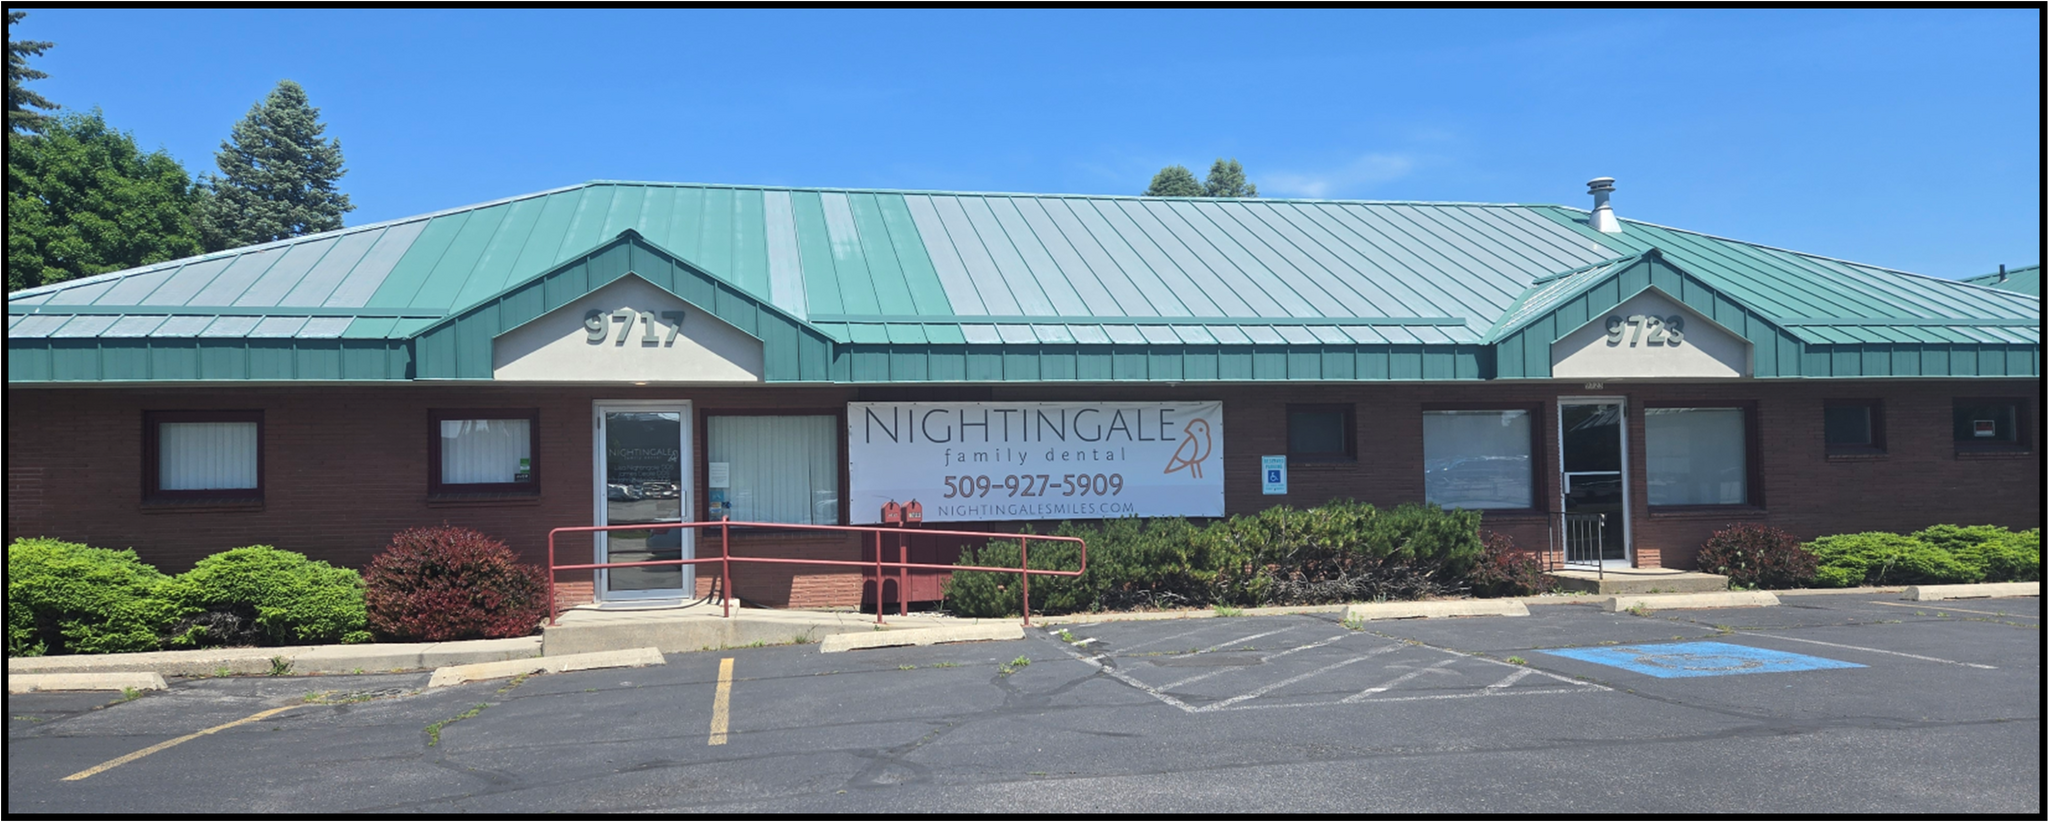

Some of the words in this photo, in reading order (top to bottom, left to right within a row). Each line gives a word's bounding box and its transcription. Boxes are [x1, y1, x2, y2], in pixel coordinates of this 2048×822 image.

[584, 309, 685, 344] 9717
[1605, 315, 1684, 344] 9723
[865, 406, 1177, 443] NIGHTINGALE
[609, 448, 671, 456] NIGHTINGALE
[945, 448, 1027, 466] family
[1045, 447, 1125, 461] dental
[943, 474, 1124, 499] 509-927-5909
[938, 503, 1134, 517] NIGHTINGALESMILES.COM
